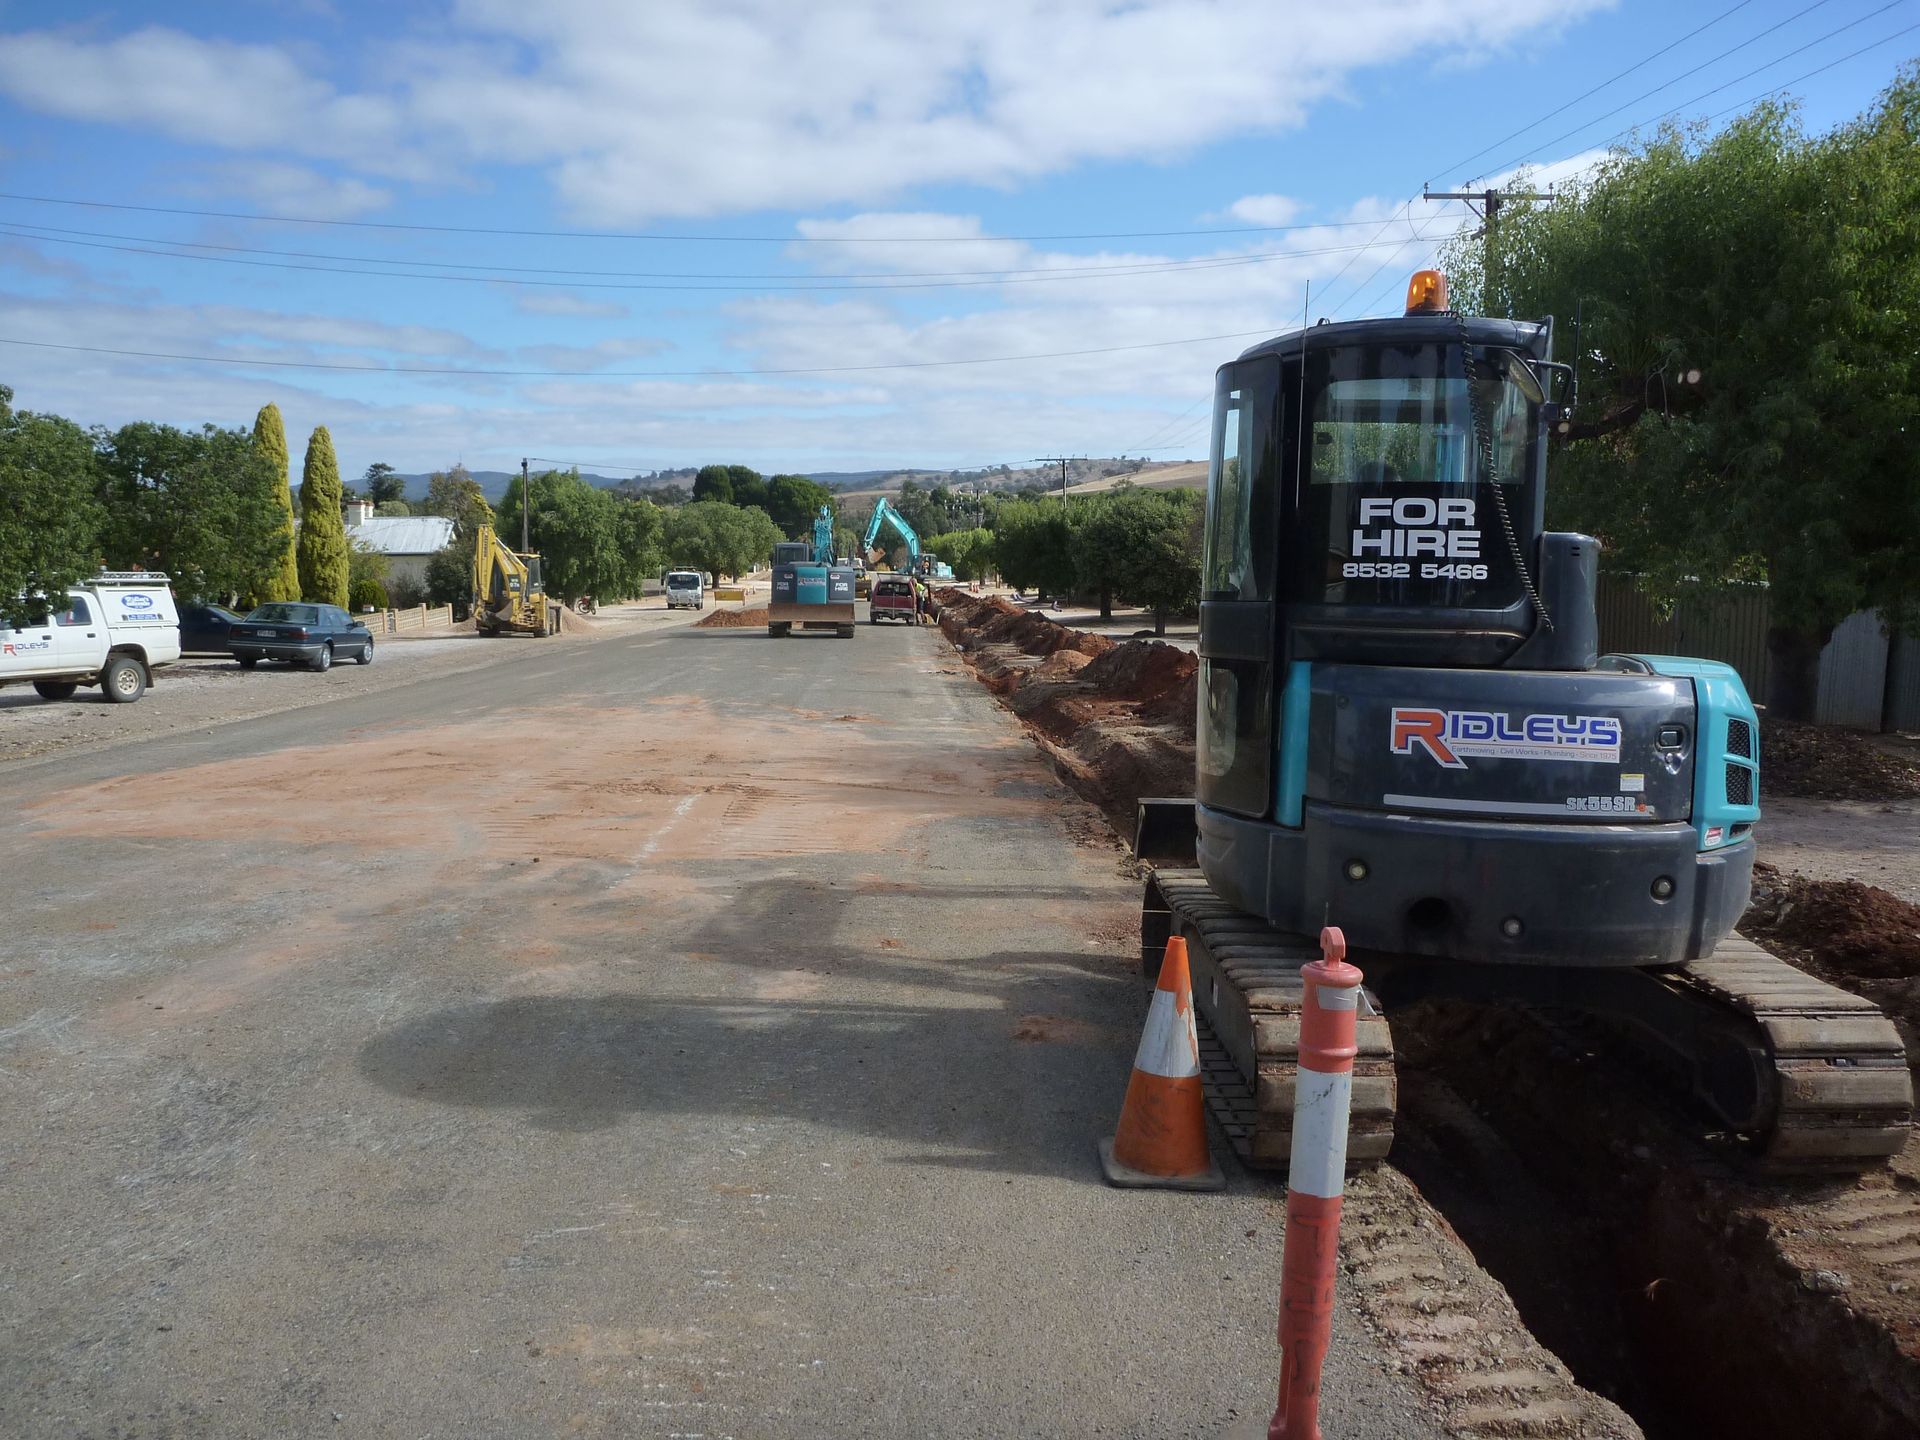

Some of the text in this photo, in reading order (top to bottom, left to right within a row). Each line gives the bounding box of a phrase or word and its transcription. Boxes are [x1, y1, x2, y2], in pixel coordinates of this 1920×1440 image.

[1359, 497, 1476, 526] FOR
[1351, 529, 1481, 558] HIRE
[1342, 562, 1488, 580] 8532 5466
[3, 641, 49, 657] RIDLEYS
[1393, 710, 1618, 764] RIDLEYS
[1451, 745, 1495, 755] Earthmoving
[1543, 749, 1575, 758] Plumbing
